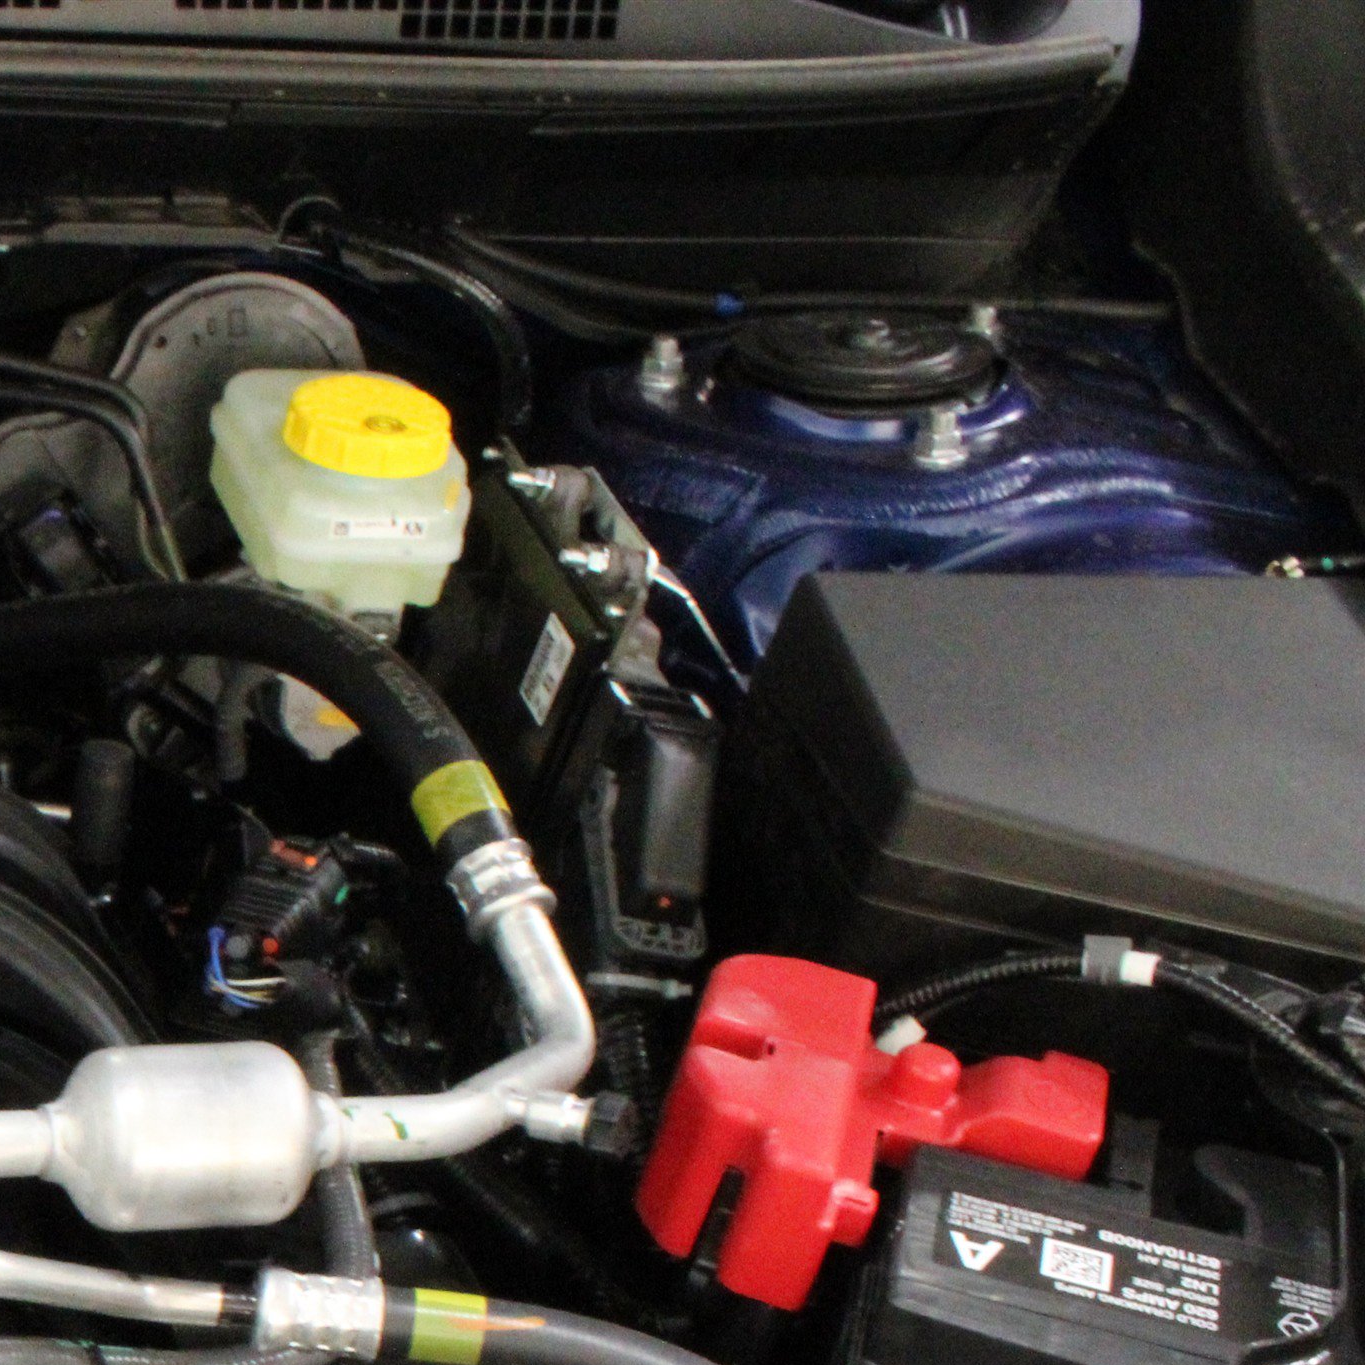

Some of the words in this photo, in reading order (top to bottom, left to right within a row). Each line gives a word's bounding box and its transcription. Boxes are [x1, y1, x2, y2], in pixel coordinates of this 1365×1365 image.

[949, 1230, 1005, 1271] A
[1181, 1276, 1219, 1296] LN2
[1121, 1287, 1181, 1311] AMPS
[1175, 1314, 1218, 1331] COLD
